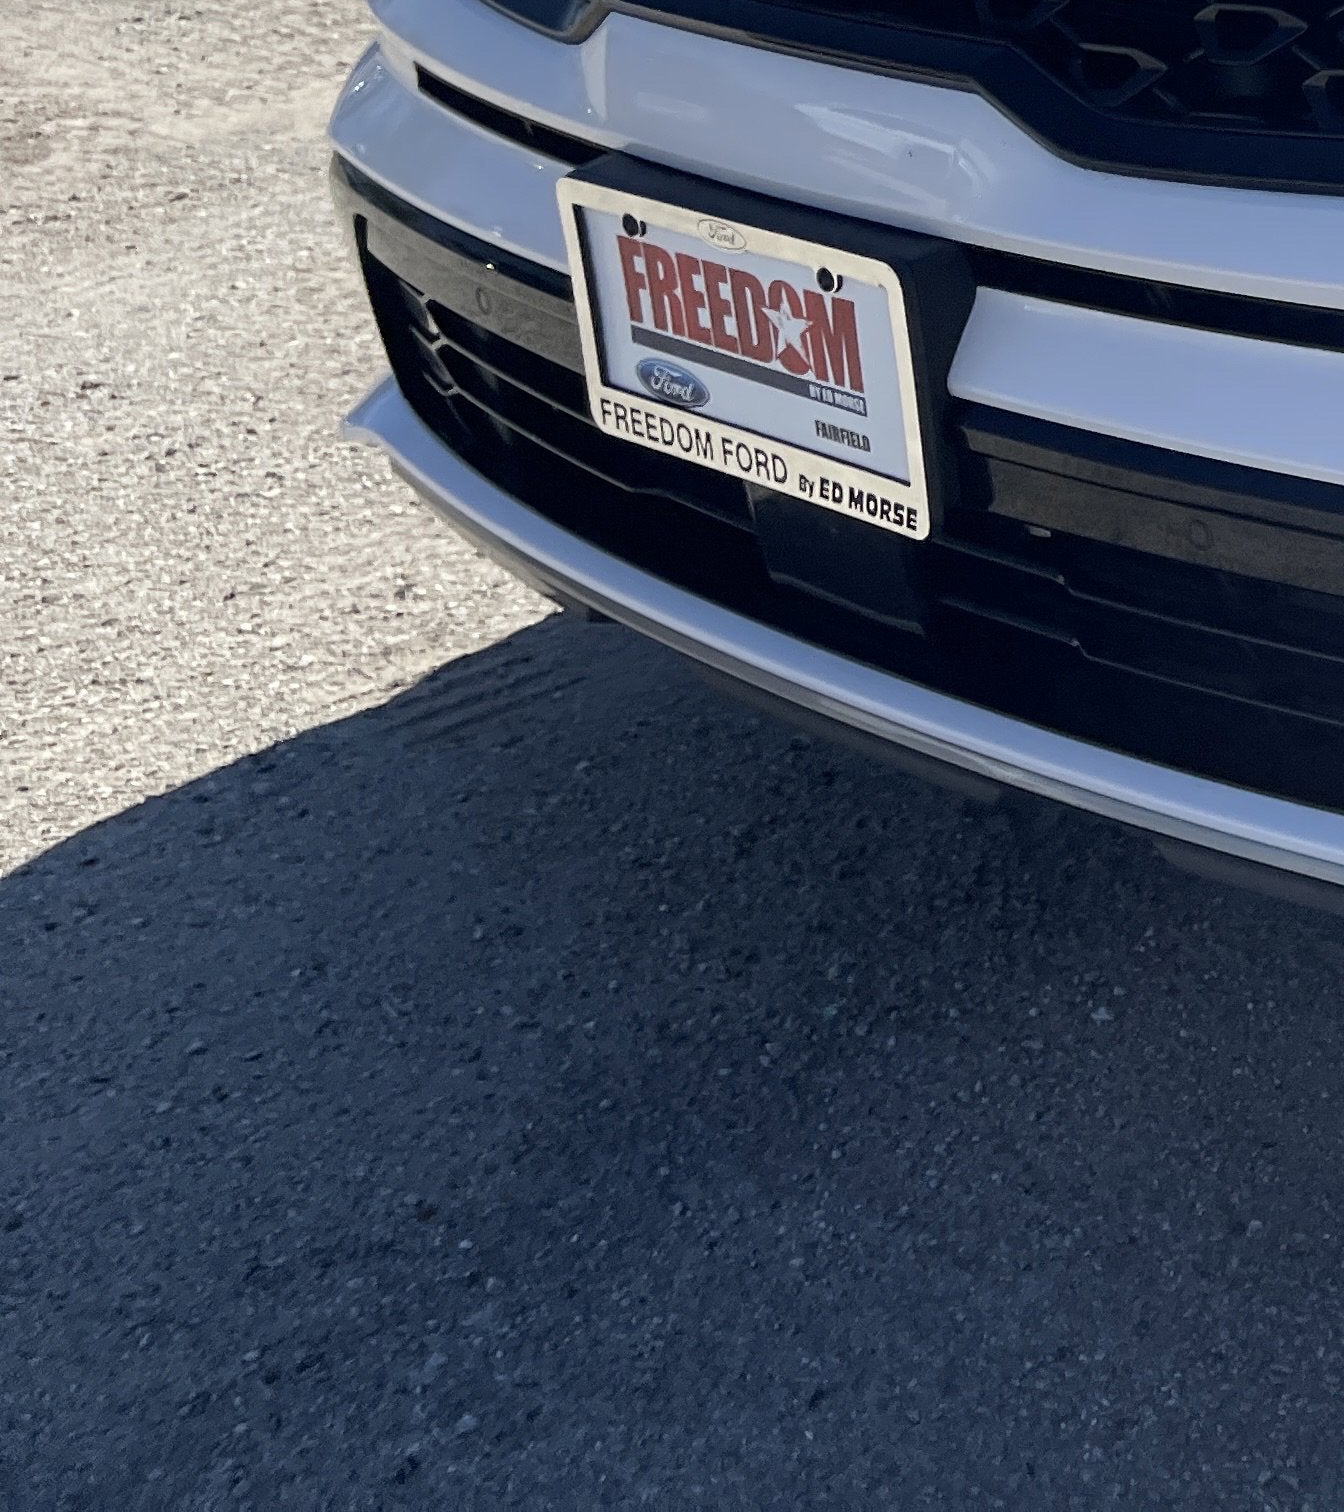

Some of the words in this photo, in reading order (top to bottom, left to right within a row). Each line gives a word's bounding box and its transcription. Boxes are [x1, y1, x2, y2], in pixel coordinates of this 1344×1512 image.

[616, 235, 864, 393] FREEDOM
[650, 366, 695, 402] Ford
[600, 398, 714, 461] FREEDOM
[721, 436, 788, 483] FORD
[820, 476, 843, 503] ED
[848, 486, 918, 531] MORSE
[814, 419, 871, 452] FAIRFIELD
